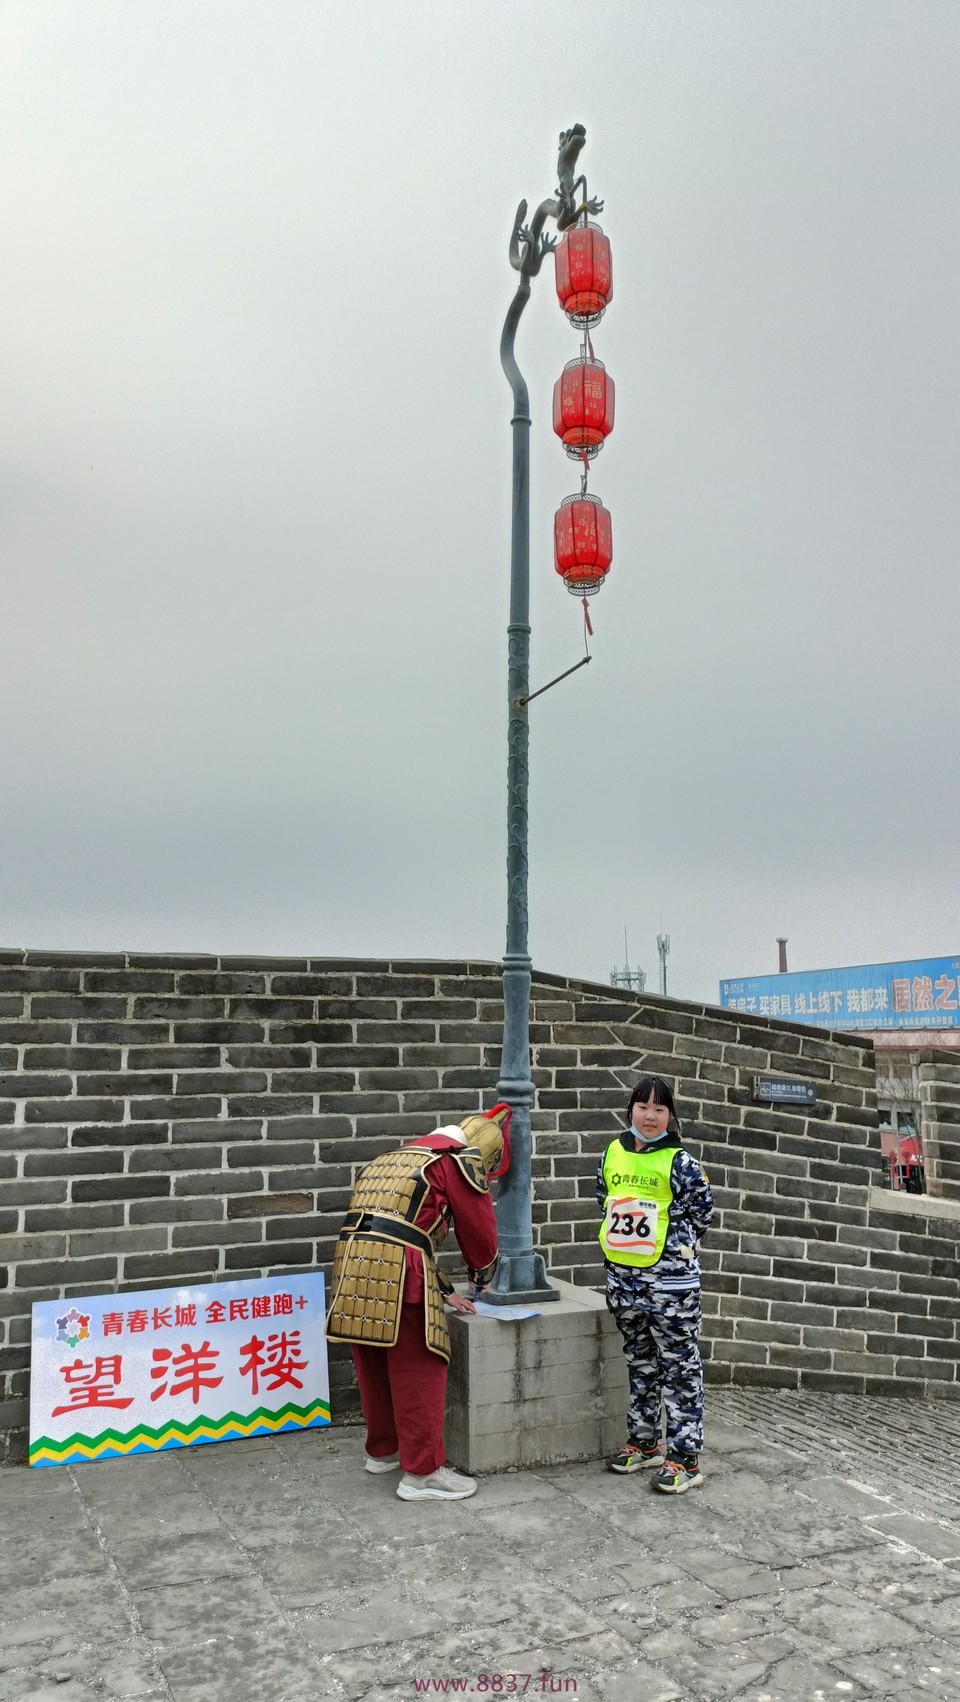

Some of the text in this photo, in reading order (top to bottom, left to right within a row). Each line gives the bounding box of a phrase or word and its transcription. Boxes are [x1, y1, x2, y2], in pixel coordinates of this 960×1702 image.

[584, 380, 602, 399] 福
[759, 994, 791, 1016] 买家具
[794, 990, 843, 1015] 线上线下
[847, 986, 888, 1013] 我都来
[892, 974, 960, 1012] 居然之
[622, 1174, 659, 1188] 青春长城
[610, 1212, 651, 1238] 236
[101, 1293, 309, 1337] 青春长城 全民健跑+
[51, 1330, 310, 1418] 望洋楼
